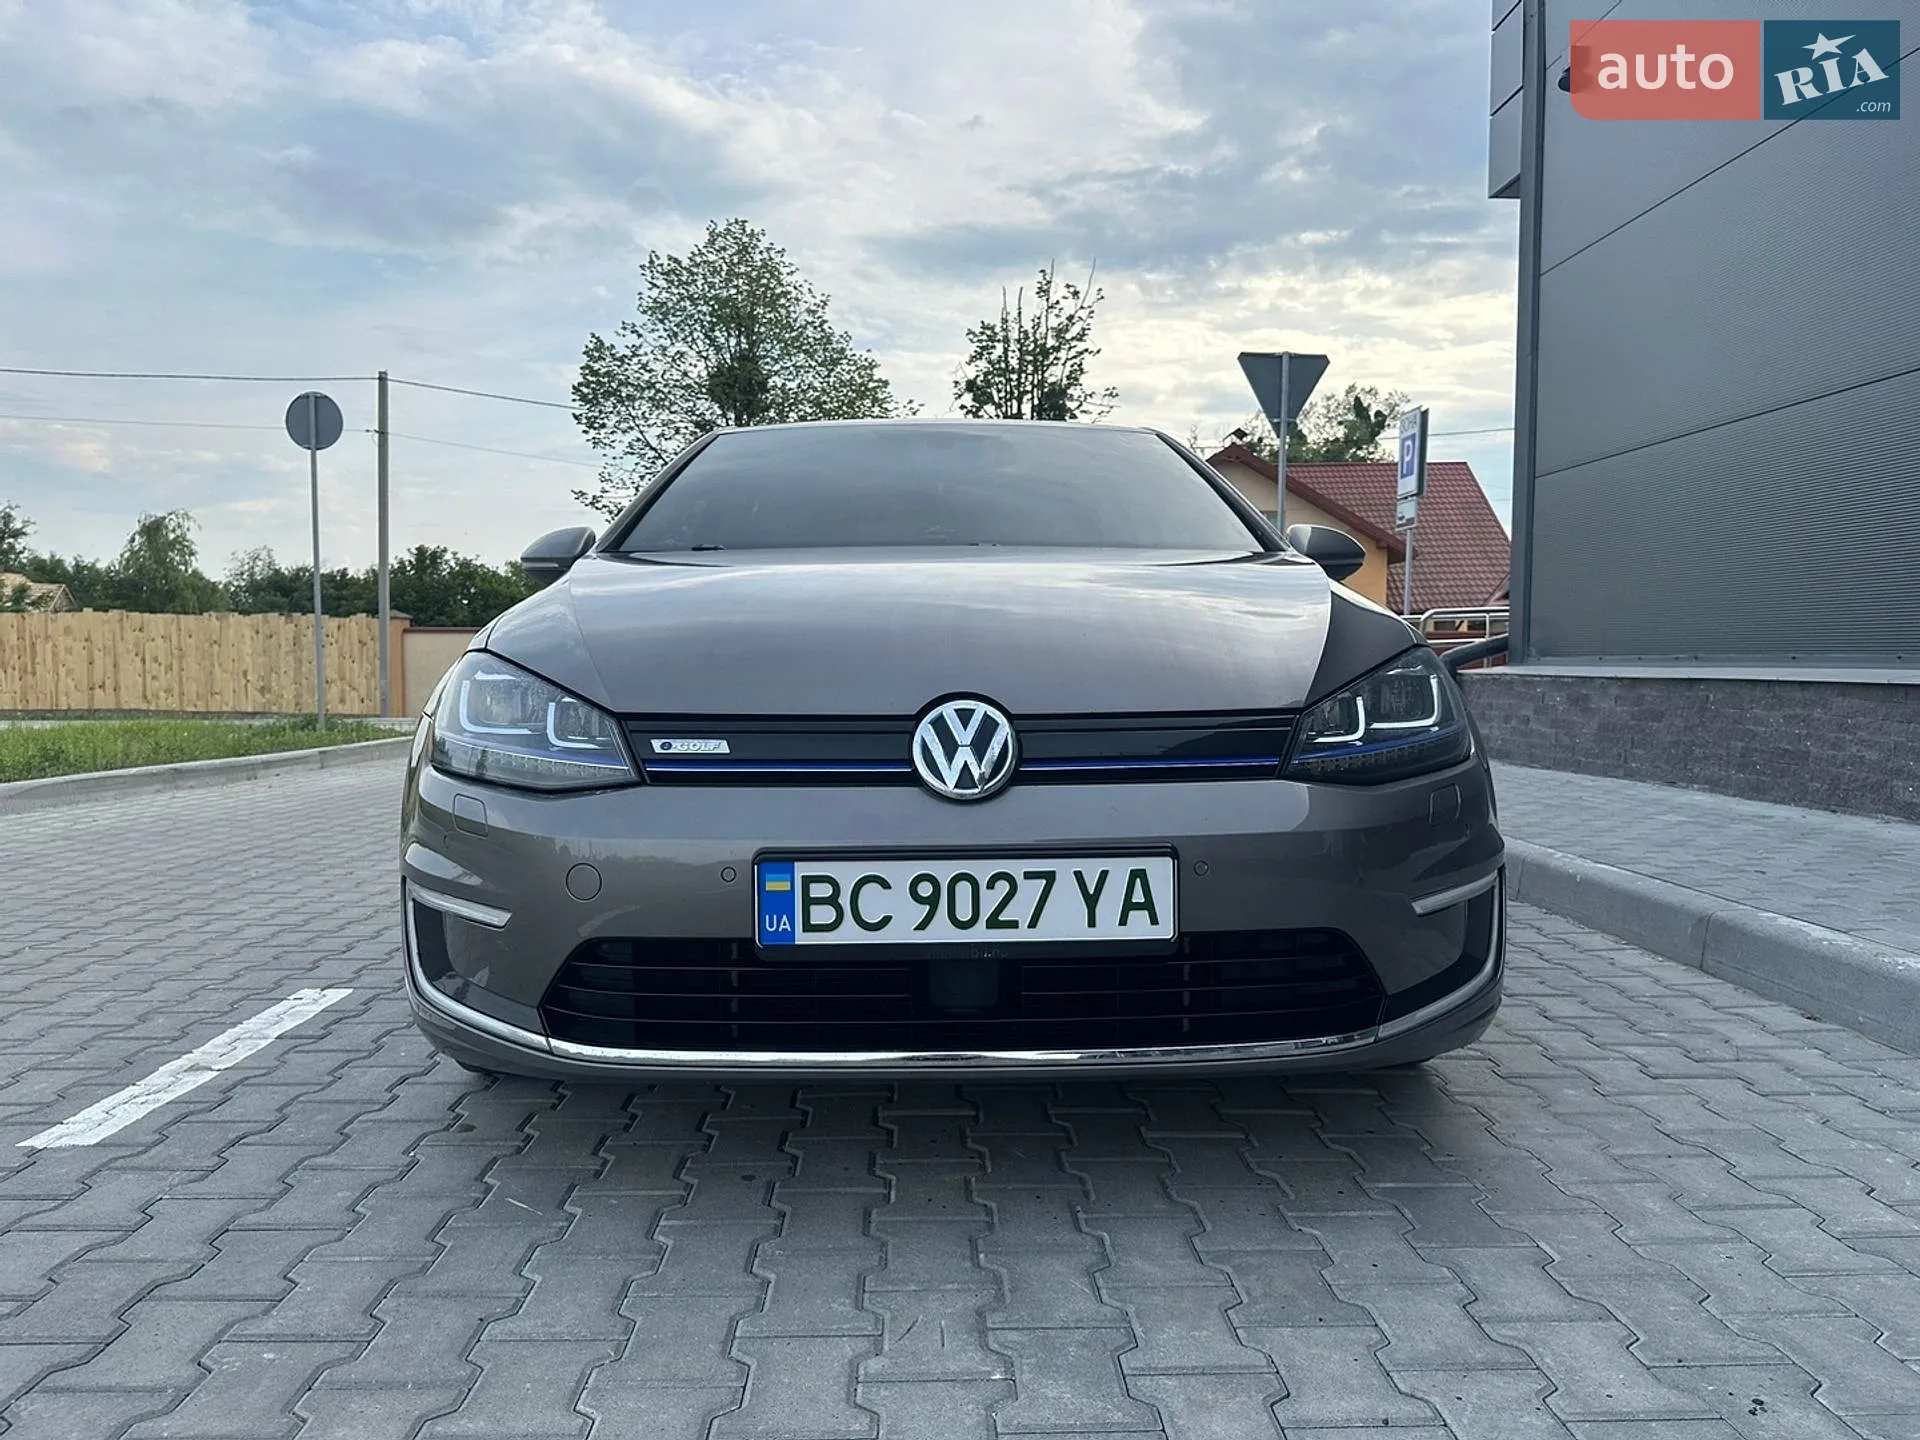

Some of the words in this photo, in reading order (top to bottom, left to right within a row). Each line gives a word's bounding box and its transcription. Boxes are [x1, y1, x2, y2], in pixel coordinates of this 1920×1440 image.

[801, 874, 893, 933] BC
[908, 870, 1057, 931] 9027
[1073, 867, 1160, 929] YA
[765, 914, 792, 932] UA
